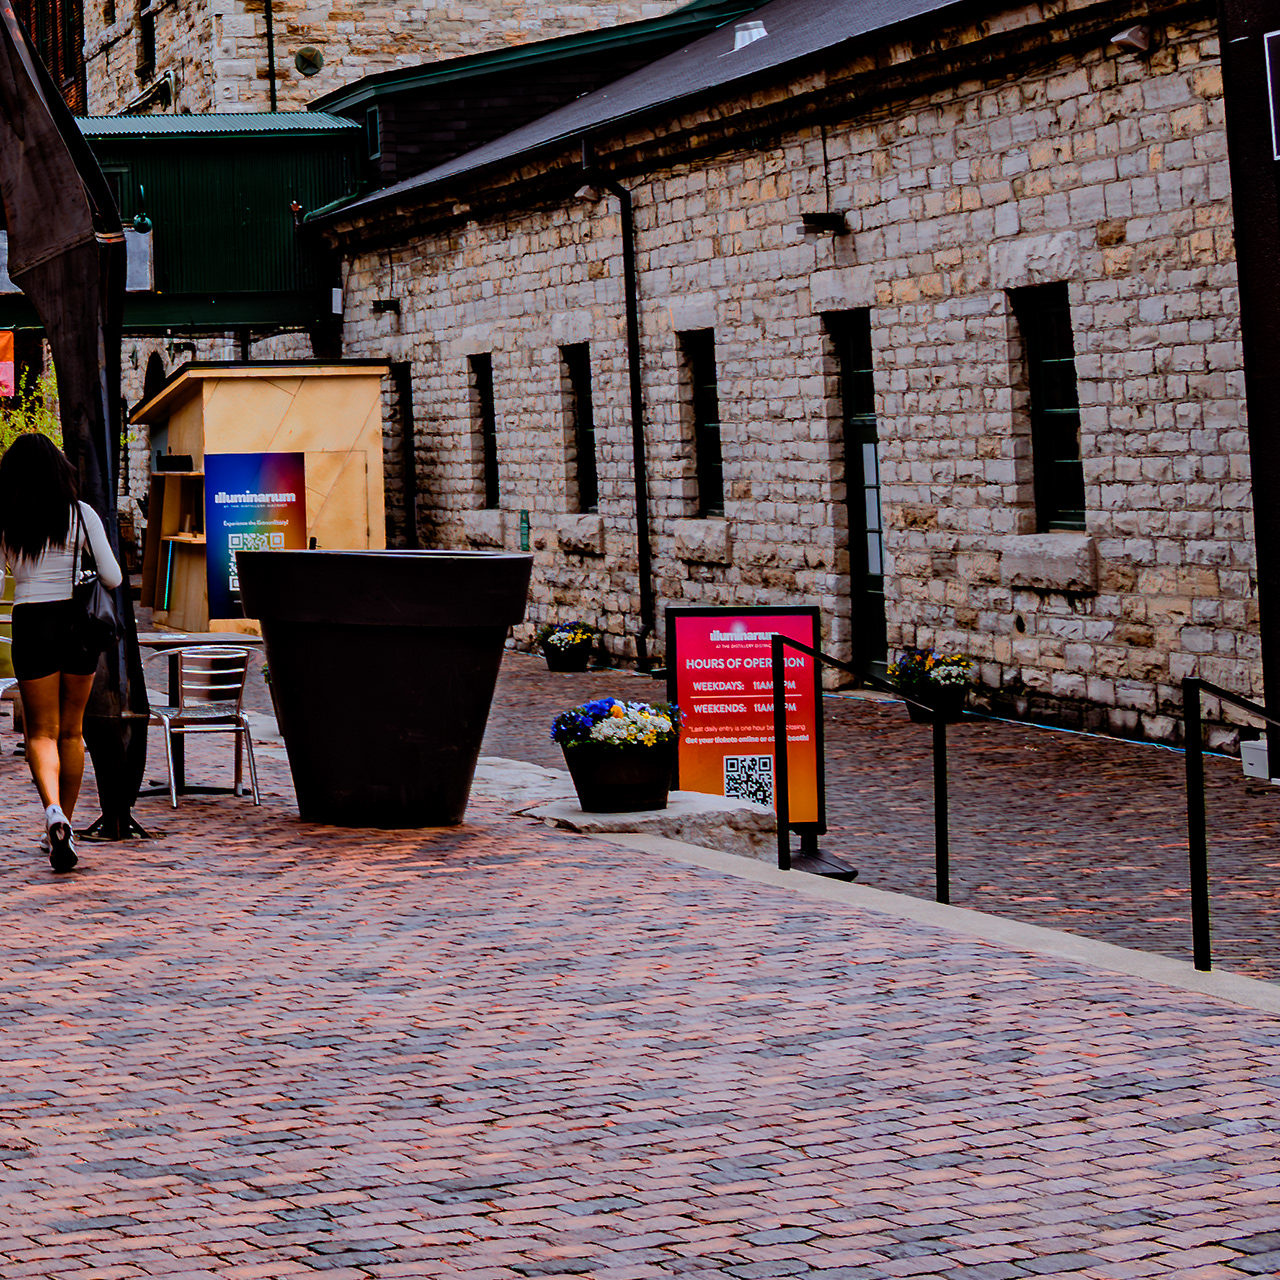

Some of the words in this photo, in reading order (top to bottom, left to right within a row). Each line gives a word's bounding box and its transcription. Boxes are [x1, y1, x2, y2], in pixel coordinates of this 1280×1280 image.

[215, 490, 296, 504] illuminarium
[686, 659, 725, 670] HOURS
[726, 658, 742, 669] OF
[743, 657, 805, 669] OPERION
[692, 681, 745, 692] WEEKDAYS:
[693, 704, 747, 713] WEEKENDS:
[704, 725, 718, 733] daily
[698, 737, 714, 745] your
[714, 736, 738, 744] tickets
[738, 735, 760, 743] online
